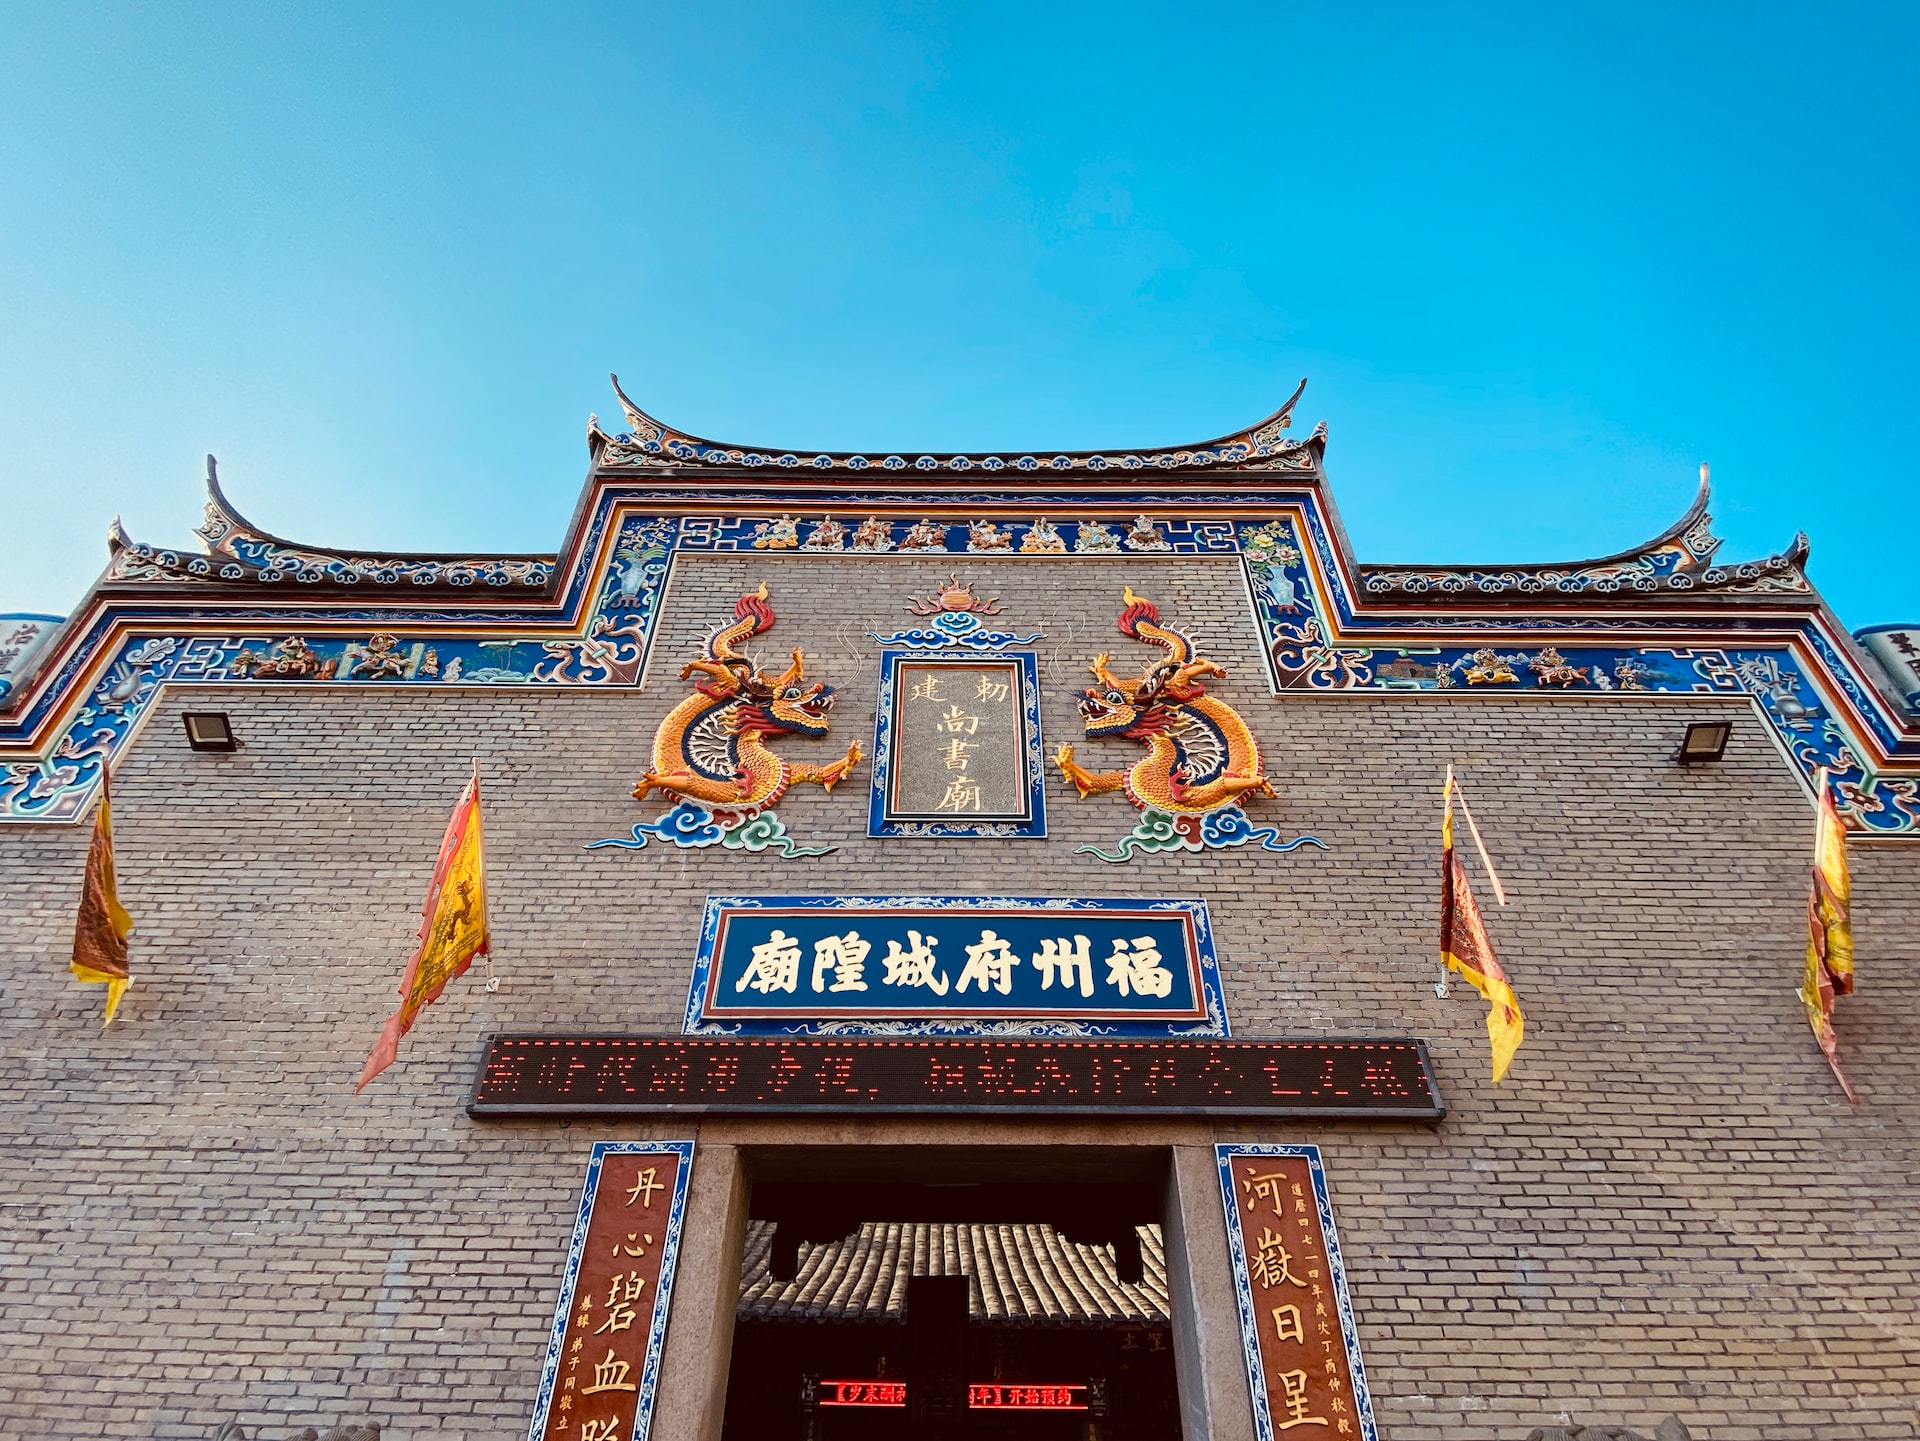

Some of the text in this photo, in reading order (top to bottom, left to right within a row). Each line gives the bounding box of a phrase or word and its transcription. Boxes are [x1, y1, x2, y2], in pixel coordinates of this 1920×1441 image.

[934, 704, 982, 812] 尚書廟
[735, 929, 1173, 998] 福州府城隍廟
